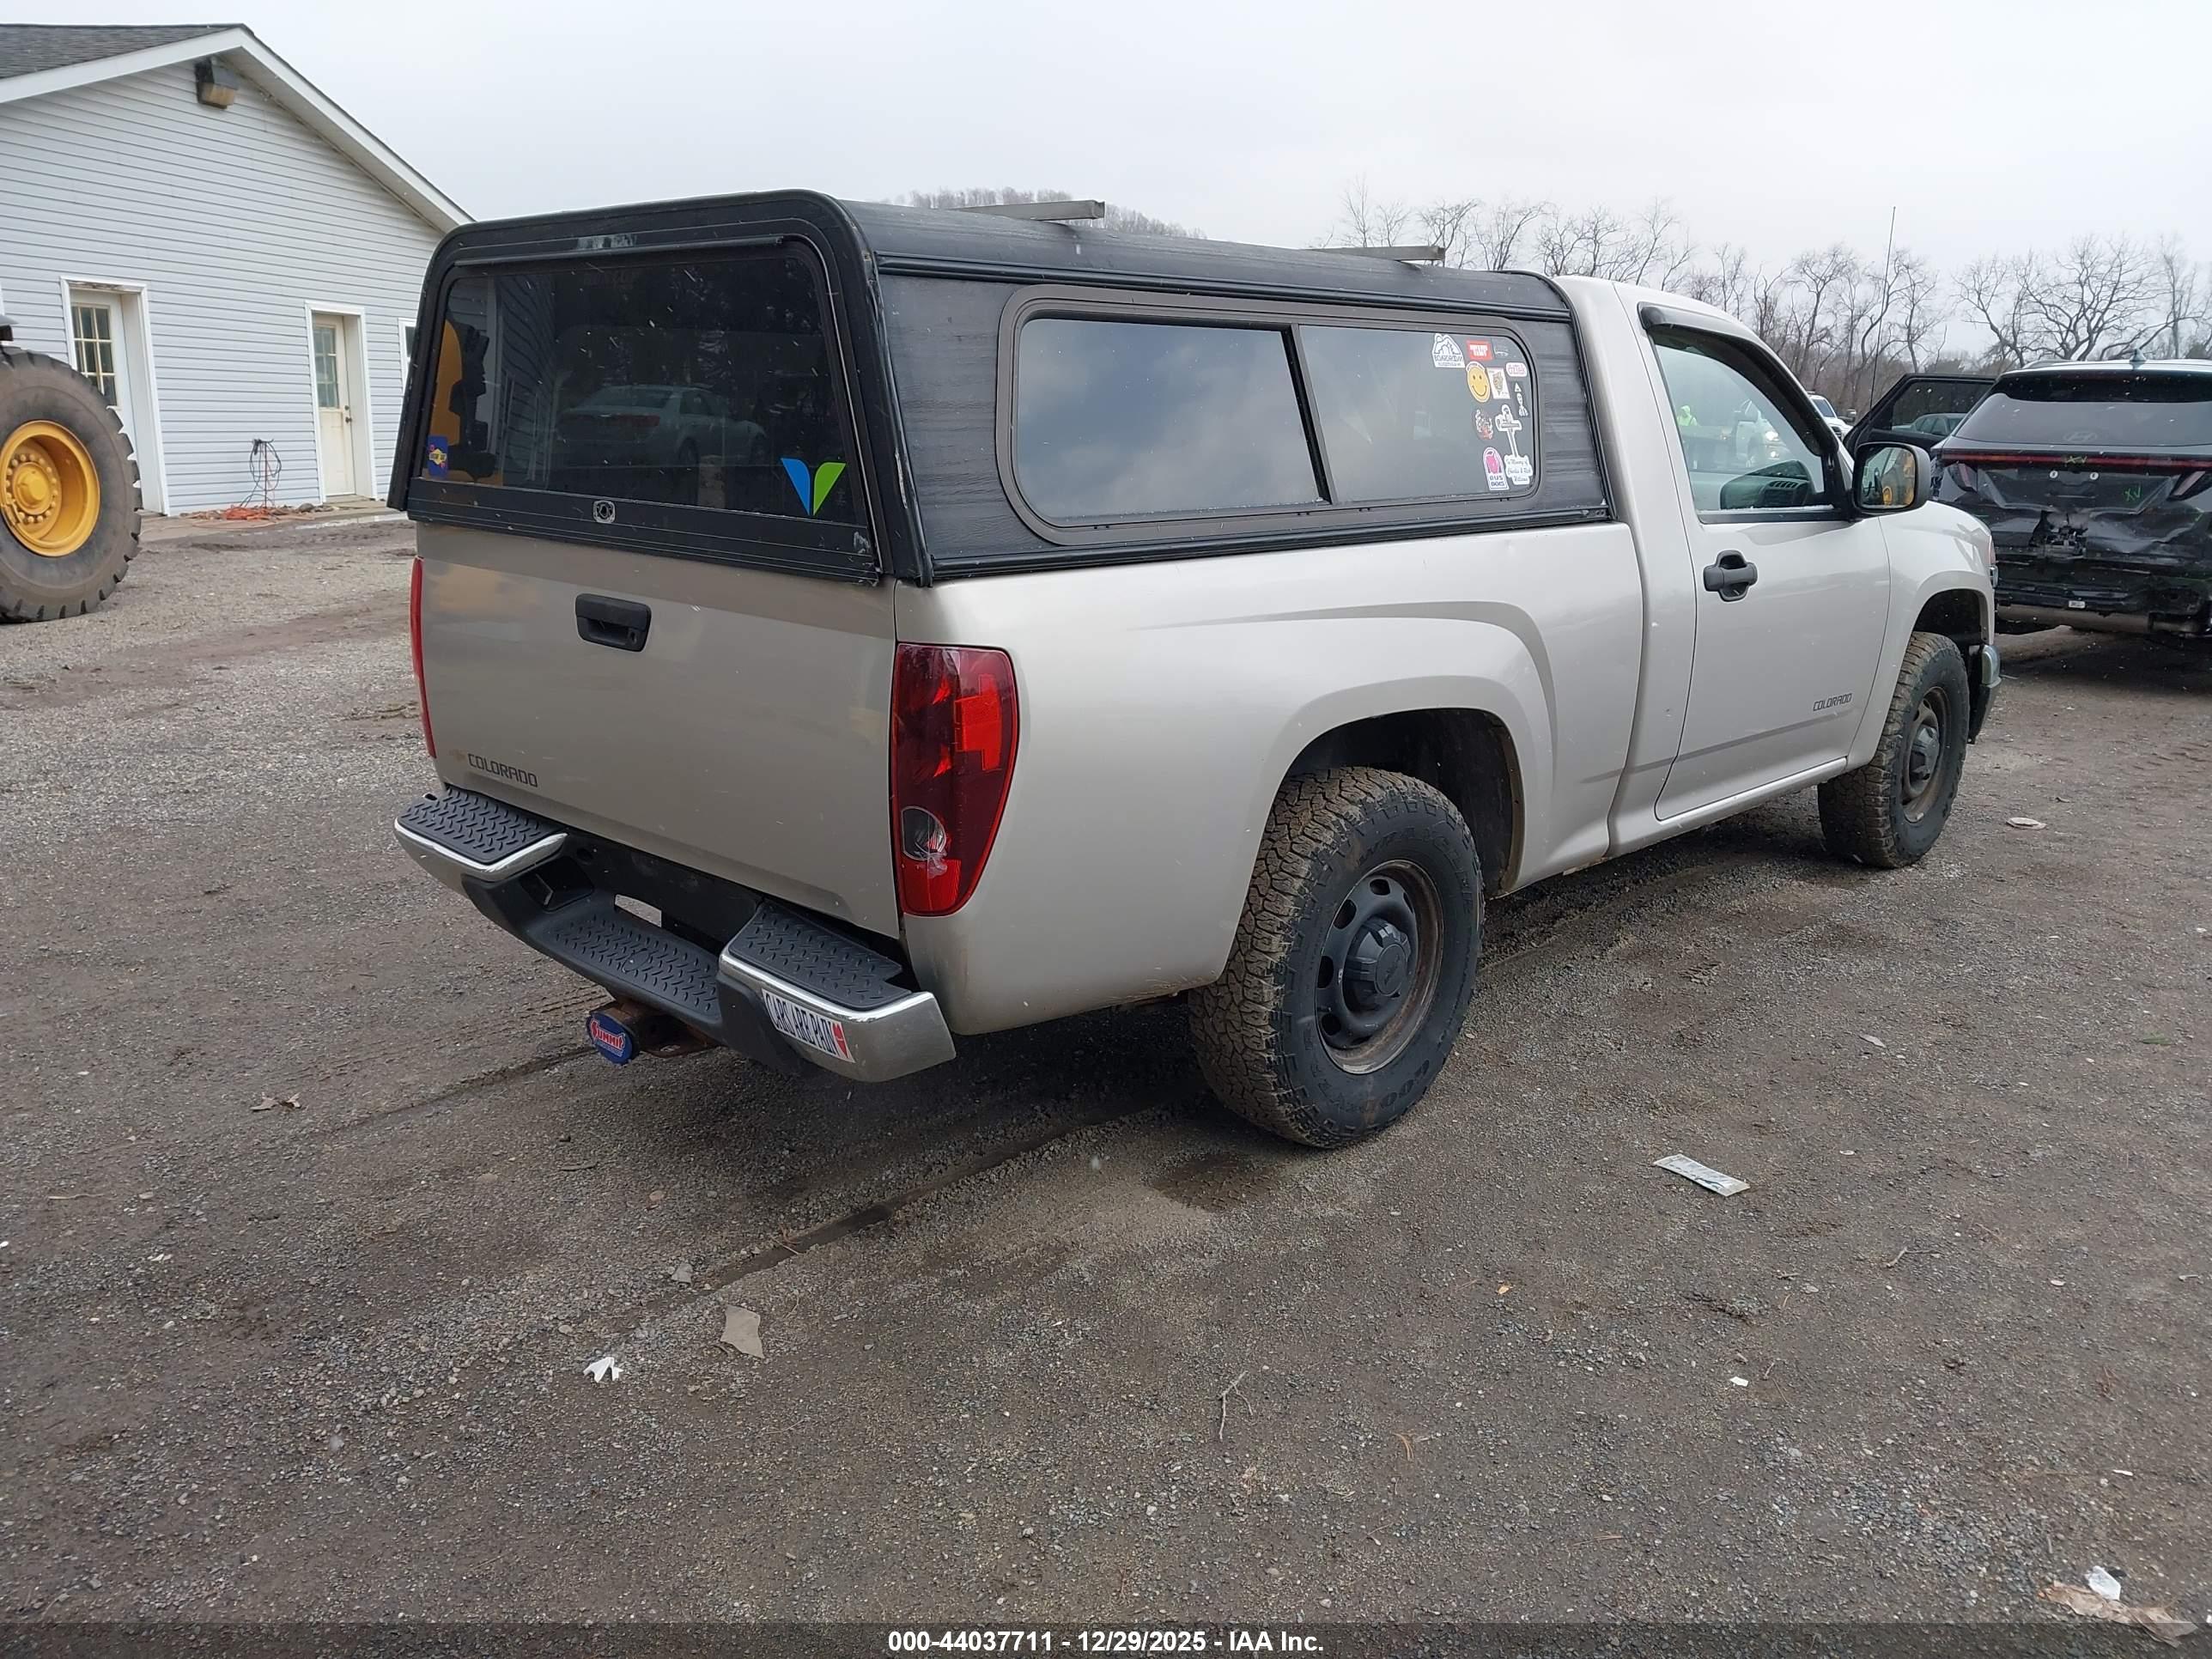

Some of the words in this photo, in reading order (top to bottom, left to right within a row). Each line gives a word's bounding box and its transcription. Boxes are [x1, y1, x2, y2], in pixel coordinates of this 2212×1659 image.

[1813, 693, 1853, 712] COLORADO
[467, 753, 538, 788] COLORADO
[590, 1018, 626, 1051] SUMMIT
[765, 992, 796, 1036] CARS
[790, 1004, 817, 1046] ARE
[809, 1013, 841, 1058] PAIN
